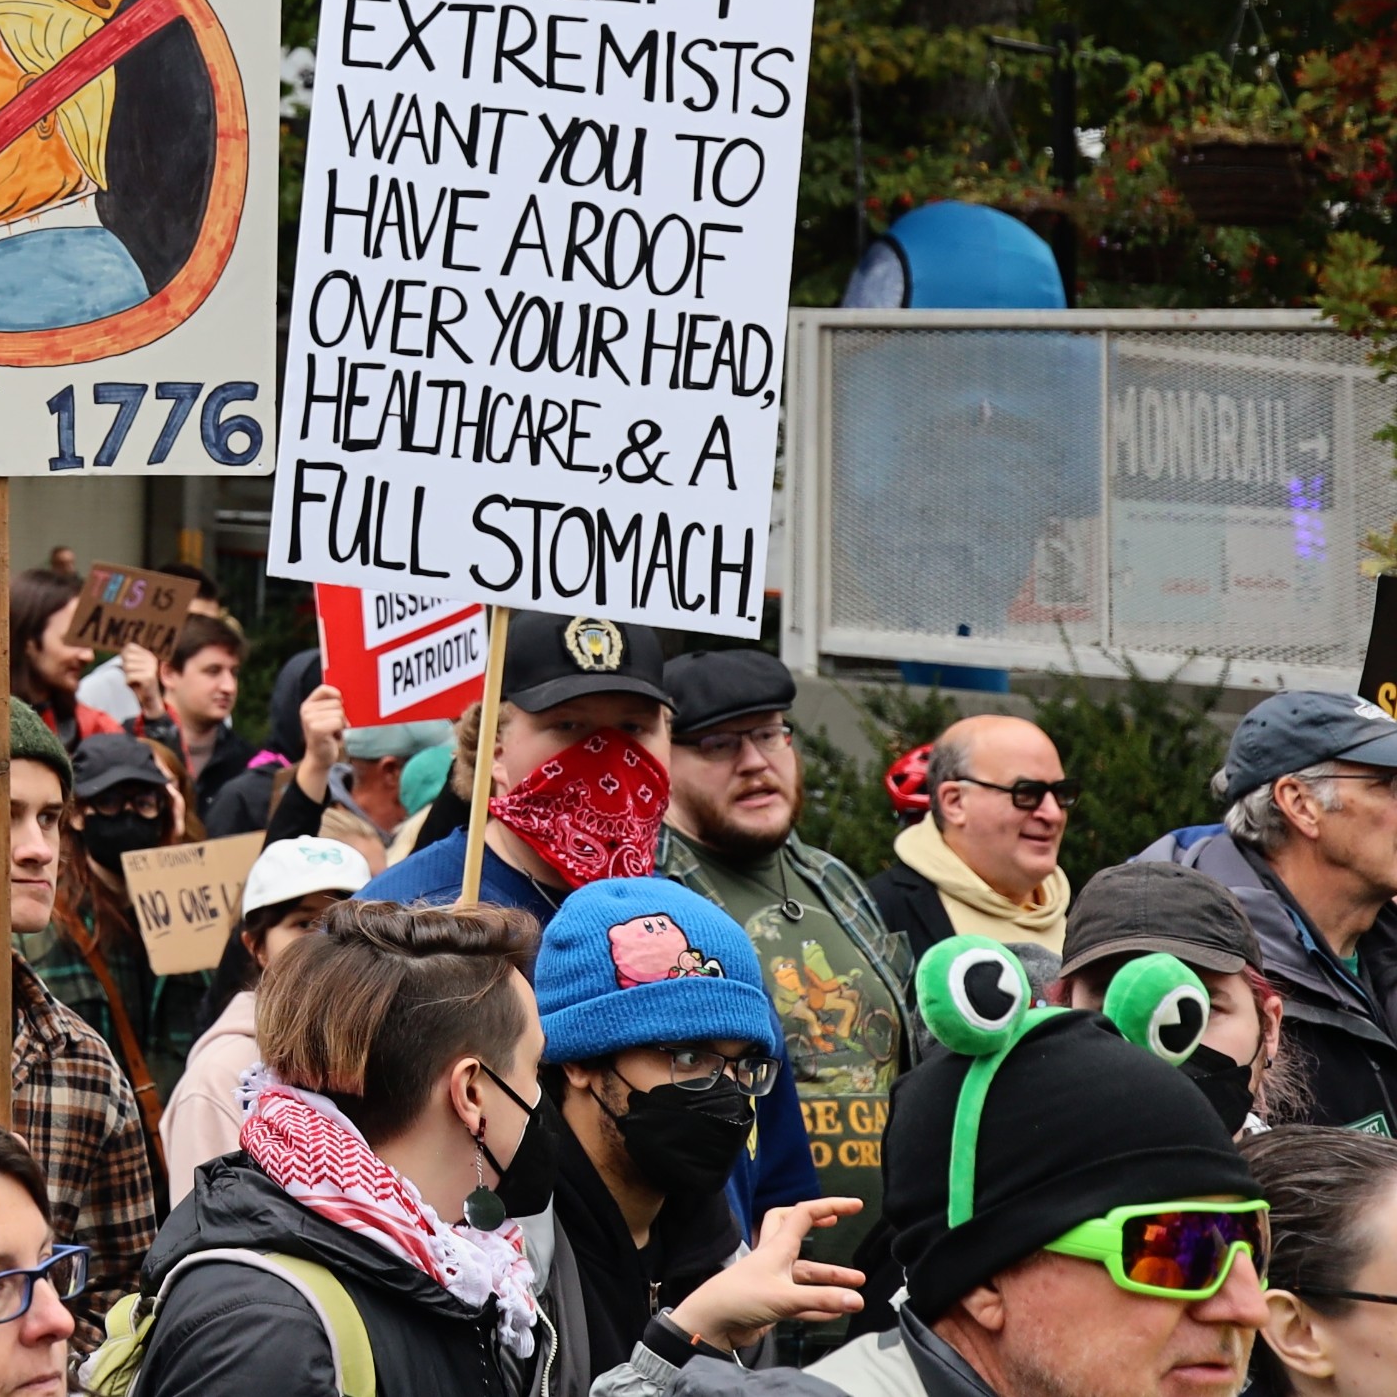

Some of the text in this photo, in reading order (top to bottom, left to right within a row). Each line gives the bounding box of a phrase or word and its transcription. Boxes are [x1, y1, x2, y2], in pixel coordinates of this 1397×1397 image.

[337, 84, 765, 207] WANT YOU TO
[324, 169, 743, 298] HAVE A ROOF
[308, 269, 775, 410] OVER YOUR HEAD,
[47, 381, 263, 470] 1776
[299, 353, 738, 490] HEALTHCARE, & A
[1109, 386, 1294, 483] MONORAIL
[92, 569, 175, 612] THIS IS
[287, 458, 757, 622] FULL STOMACH.
[392, 627, 480, 696] PATRIOTIC
[138, 890, 171, 931] NO
[179, 884, 219, 924] ONE
